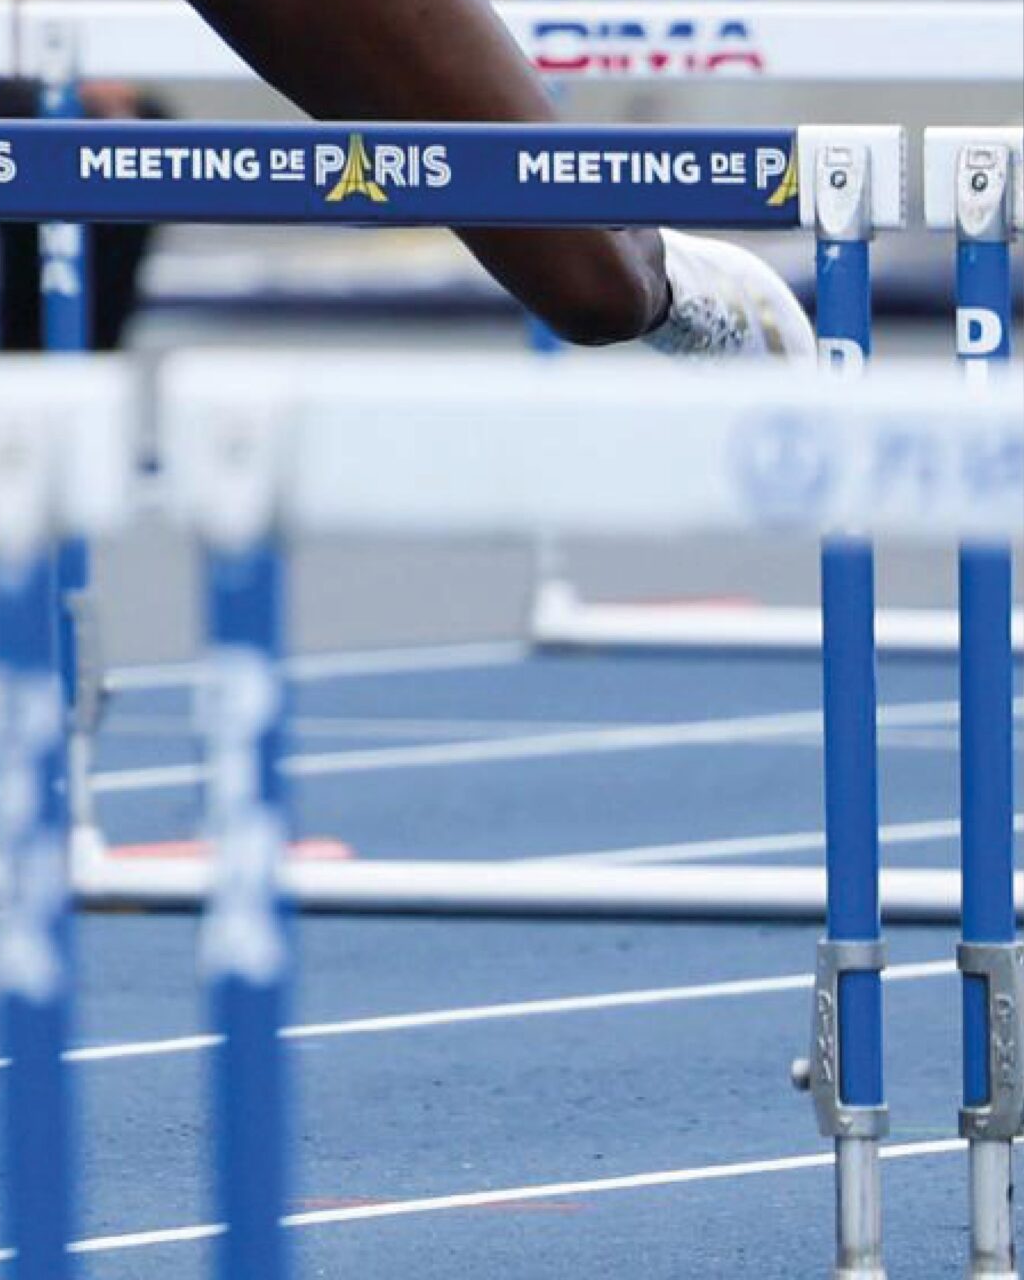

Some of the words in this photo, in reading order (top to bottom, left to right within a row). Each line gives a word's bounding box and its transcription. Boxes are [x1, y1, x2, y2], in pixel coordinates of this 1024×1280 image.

[533, 21, 762, 73] DIMA
[79, 147, 261, 180] MEETING
[270, 149, 306, 170] DE
[314, 133, 452, 202] PARIS
[517, 150, 701, 184] MEETING
[710, 152, 747, 173] DE
